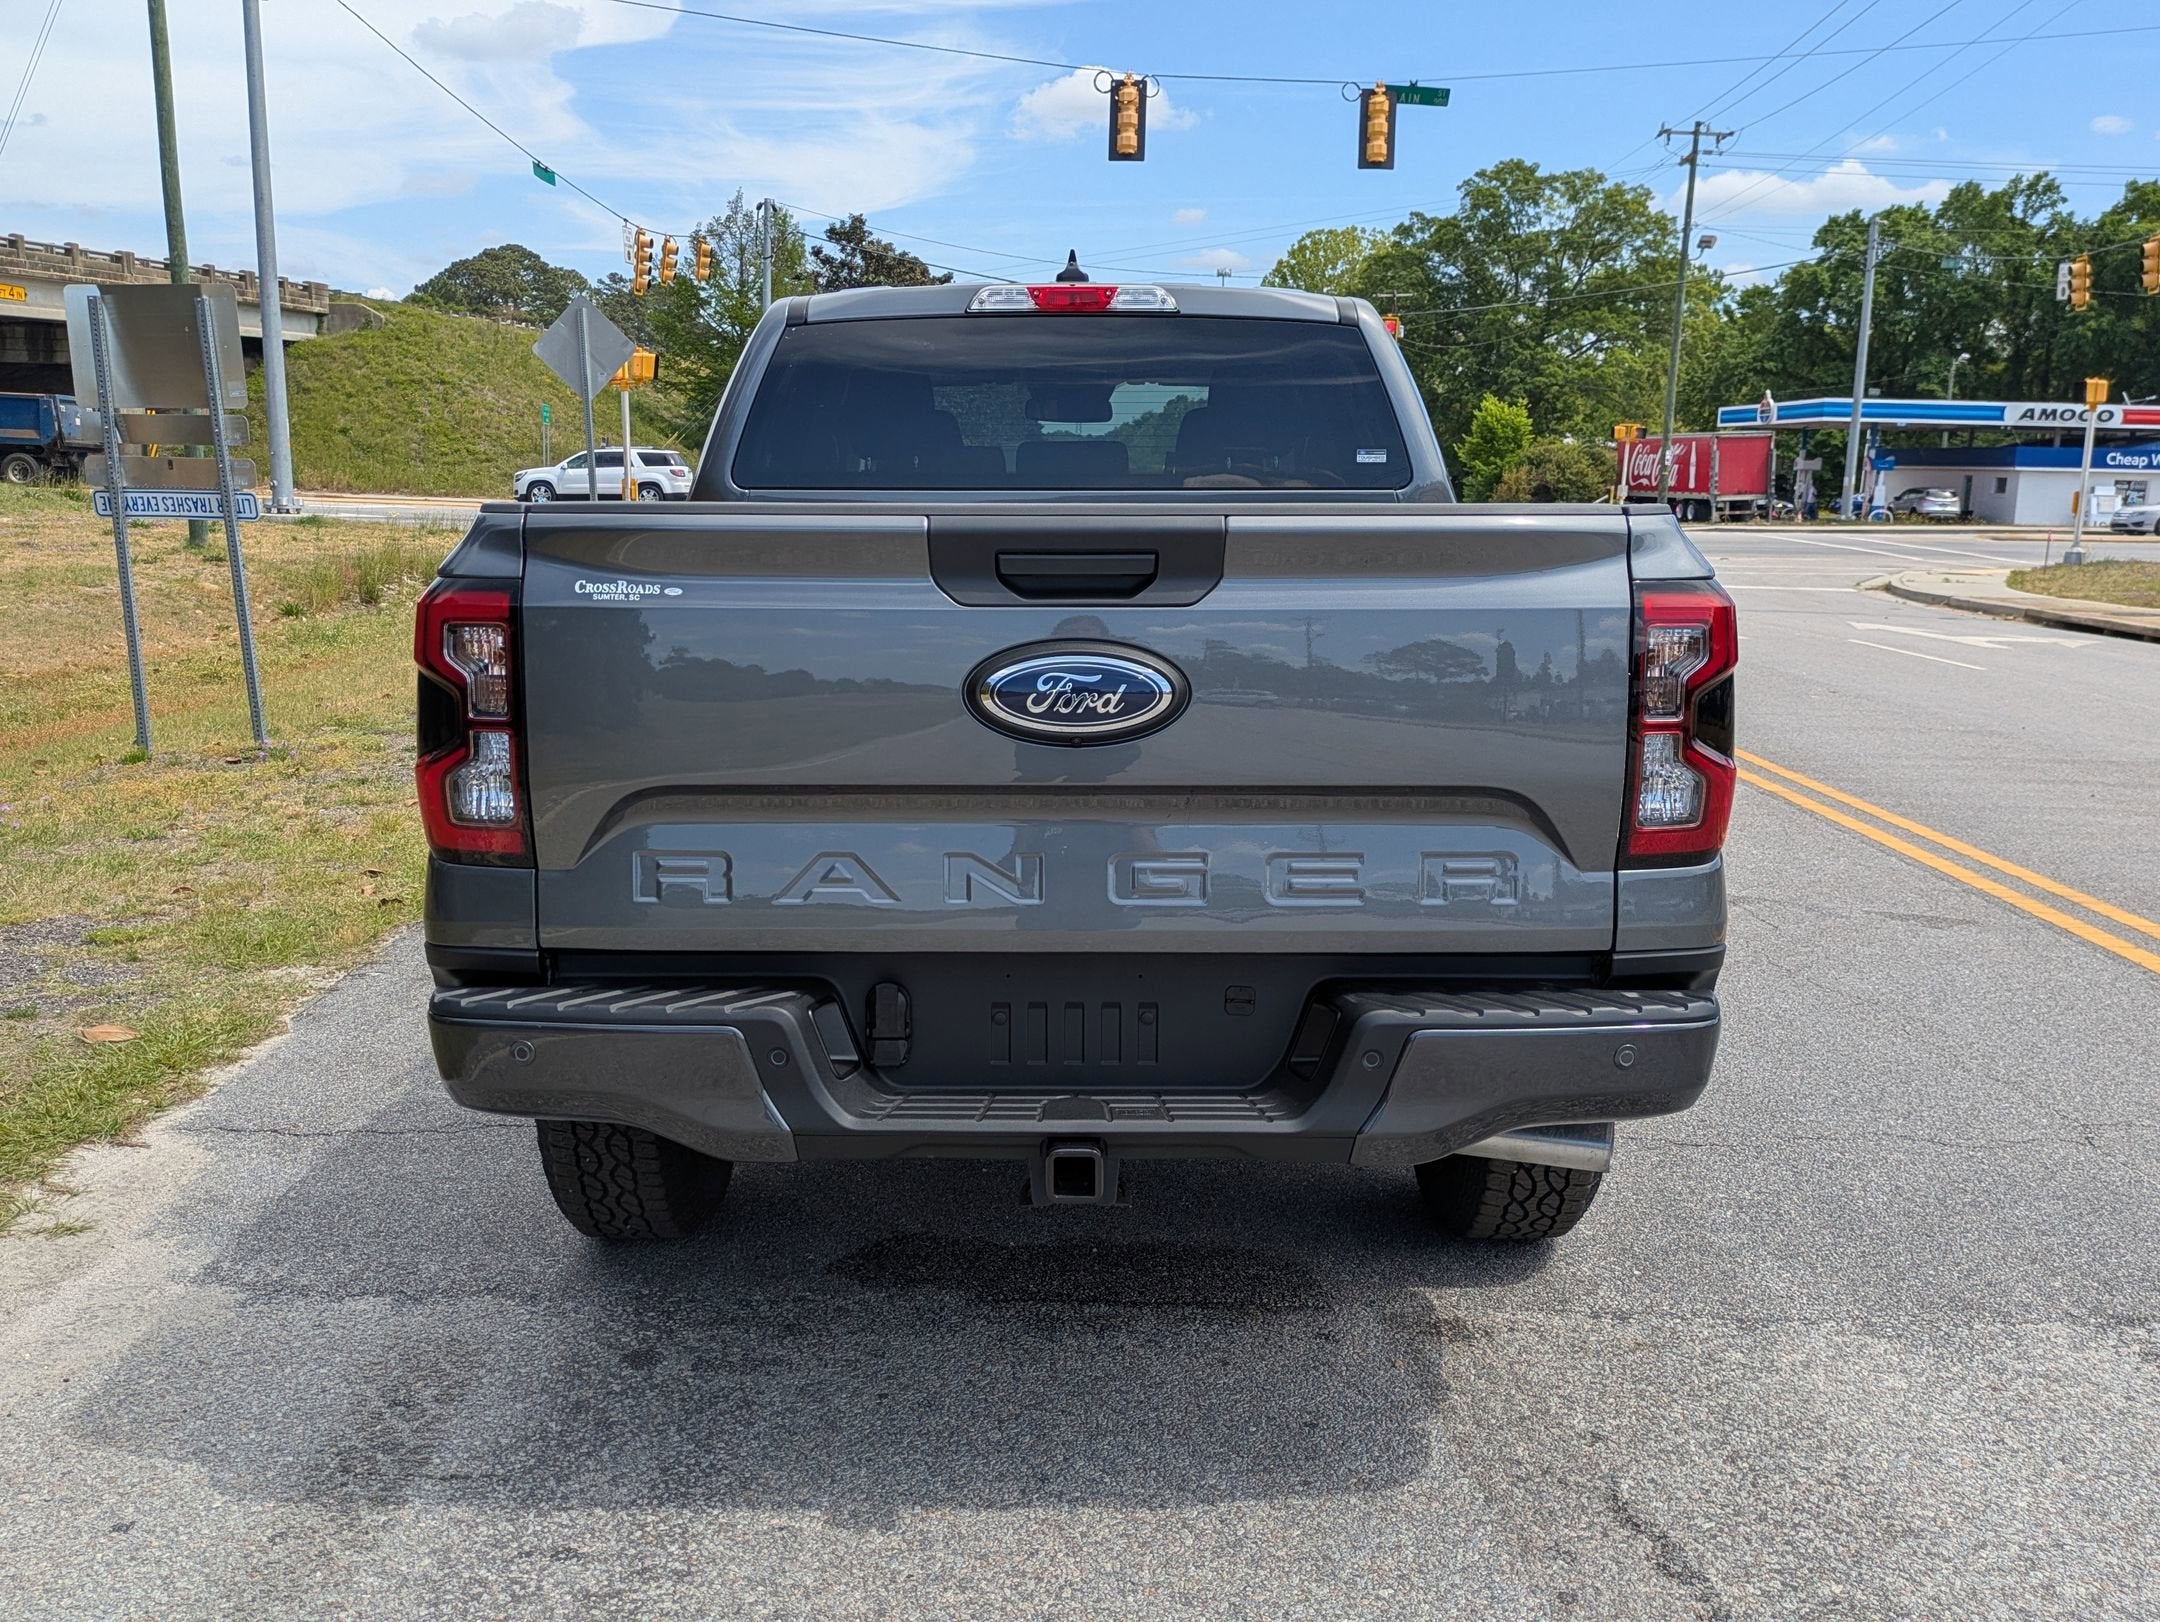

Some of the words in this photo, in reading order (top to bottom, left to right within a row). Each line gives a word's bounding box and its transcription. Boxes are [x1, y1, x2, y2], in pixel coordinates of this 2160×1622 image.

[1399, 92, 1420, 104] AIN
[9, 286, 15, 298] 4
[2018, 408, 2114, 423] AMOCO
[1629, 443, 1688, 487] Coca-Ca
[2106, 452, 2148, 468] Cheap
[99, 495, 160, 512] EVERYNE
[162, 496, 214, 513] TRASHES
[215, 497, 253, 514] LITR
[1026, 671, 1129, 714] Ford
[632, 850, 1520, 907] RANGER
